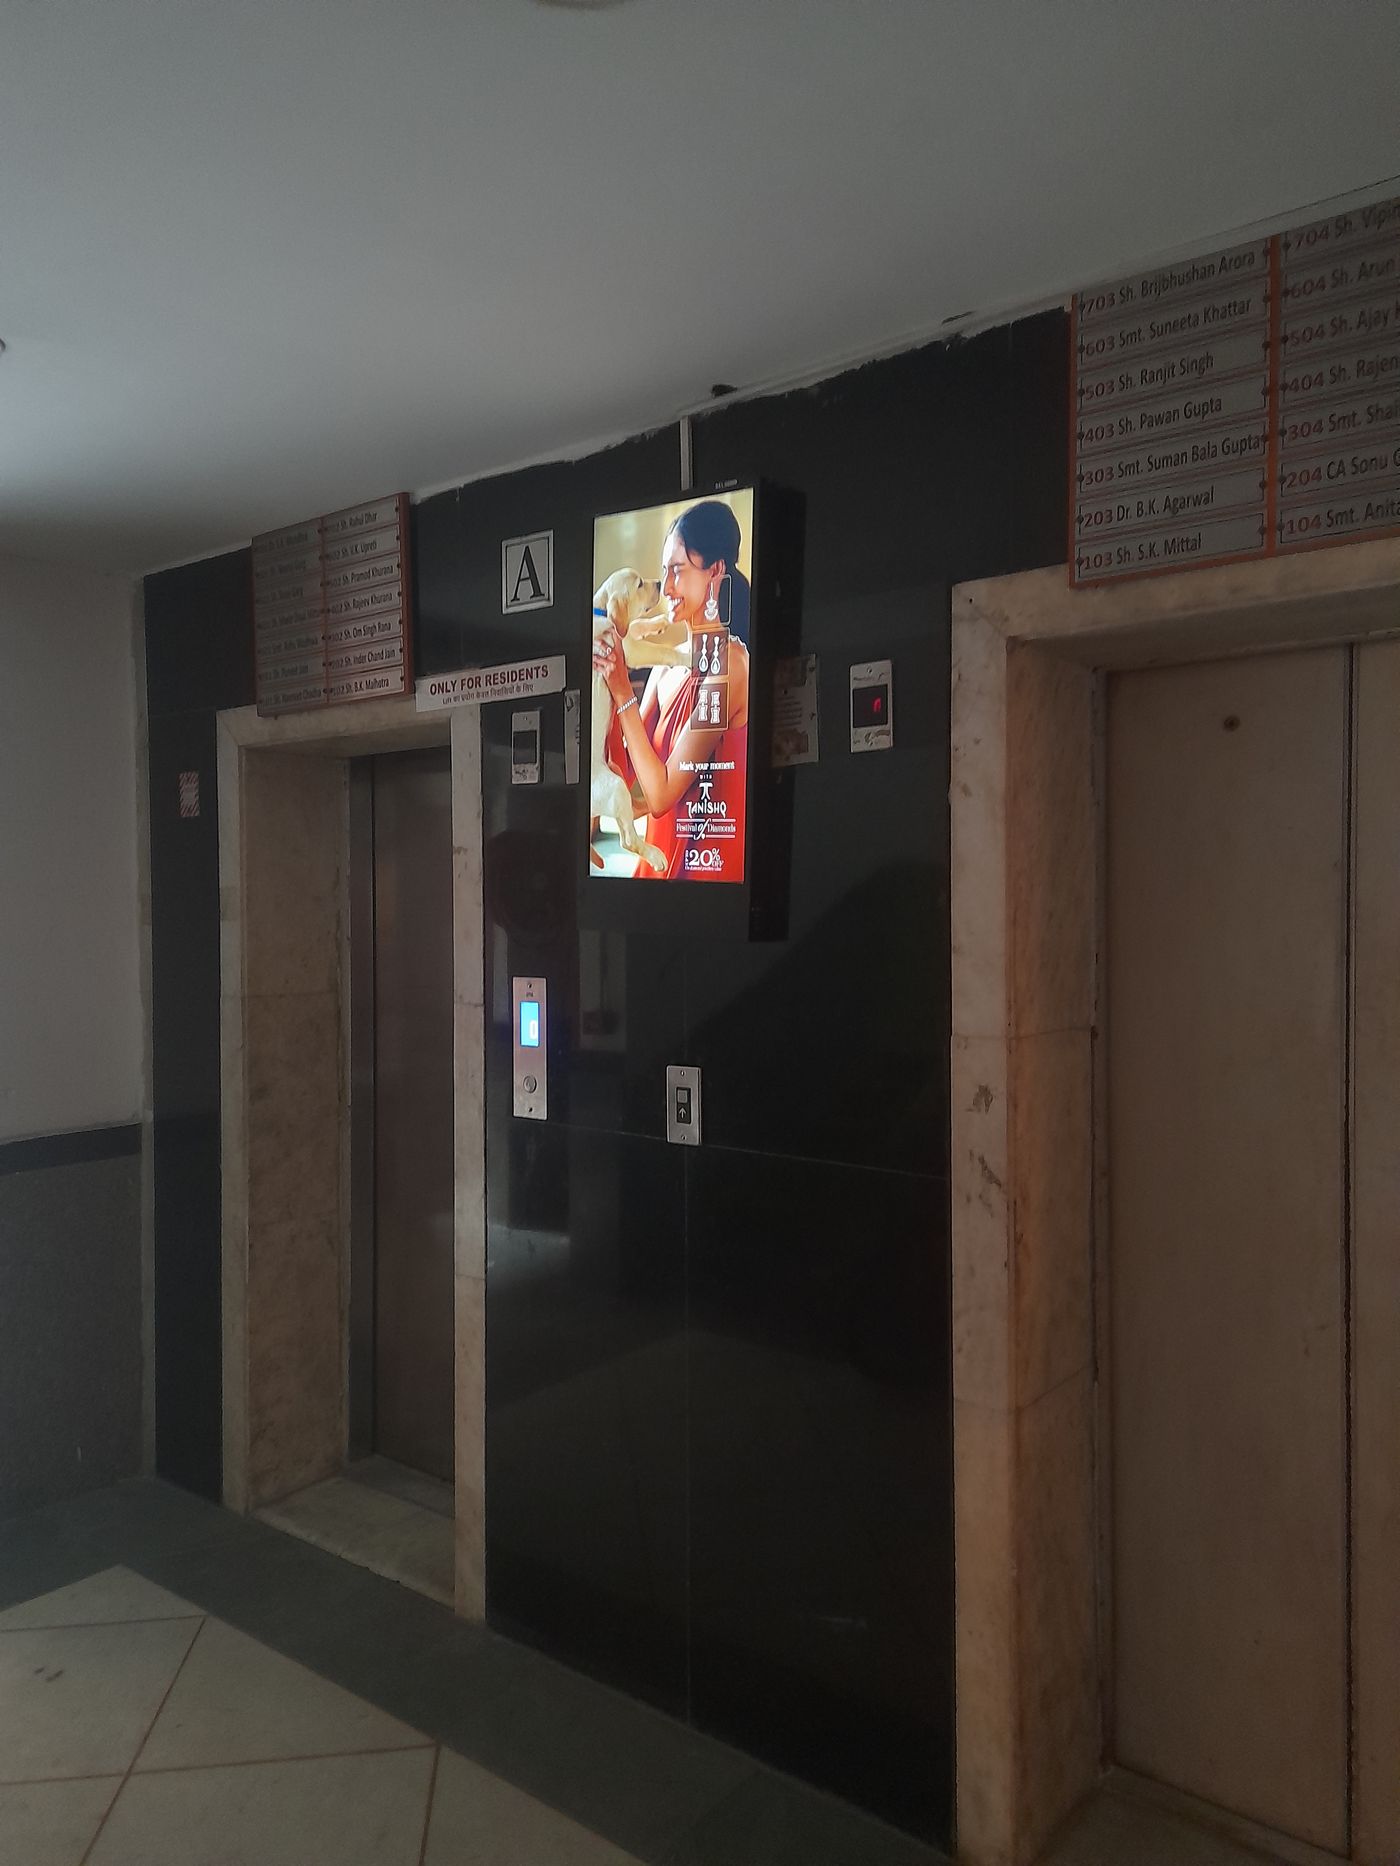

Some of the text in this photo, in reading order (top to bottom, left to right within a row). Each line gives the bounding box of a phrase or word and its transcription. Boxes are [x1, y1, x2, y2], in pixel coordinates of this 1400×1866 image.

[1296, 224, 1329, 249] 704
[1335, 215, 1353, 238] Sh.
[1087, 252, 1255, 312] 703 Sh. Brijbhushan Arora
[1290, 276, 1326, 298] 604
[1331, 268, 1353, 288] Sh.
[1086, 298, 1251, 356] 603 Smt. Suneeta Khattar
[1290, 324, 1325, 346] 504
[1331, 315, 1352, 337] Sh.
[1357, 308, 1389, 335] Ajay
[1085, 352, 1214, 401] 503 Sh. Ranjit Singh
[1290, 372, 1323, 392] 404
[1330, 365, 1351, 385] Sh.
[1085, 398, 1222, 442] 403 Sh. Pawan Gupta
[1288, 419, 1323, 440] 304
[1329, 410, 1360, 432] Smt.
[1085, 434, 1259, 485] 303 Smt. Suman Bala Gupta
[1287, 467, 1322, 488] 204
[1327, 459, 1346, 480] CA
[1351, 456, 1388, 475] Sonu
[1084, 485, 1214, 527] 203 Dr. B.K. Agarwal
[1287, 514, 1321, 534] 104
[1327, 508, 1358, 528] Smt.
[1085, 532, 1201, 570] 103 Sh. S.K. Mittal
[511, 545, 545, 602] A
[365, 677, 389, 690] Malhotra
[430, 664, 549, 695] ONLY FOR RESIDENTS
[680, 761, 735, 772] Mark your moment
[686, 799, 727, 819] TANISHQ
[676, 818, 736, 840] Festival of Diamonds
